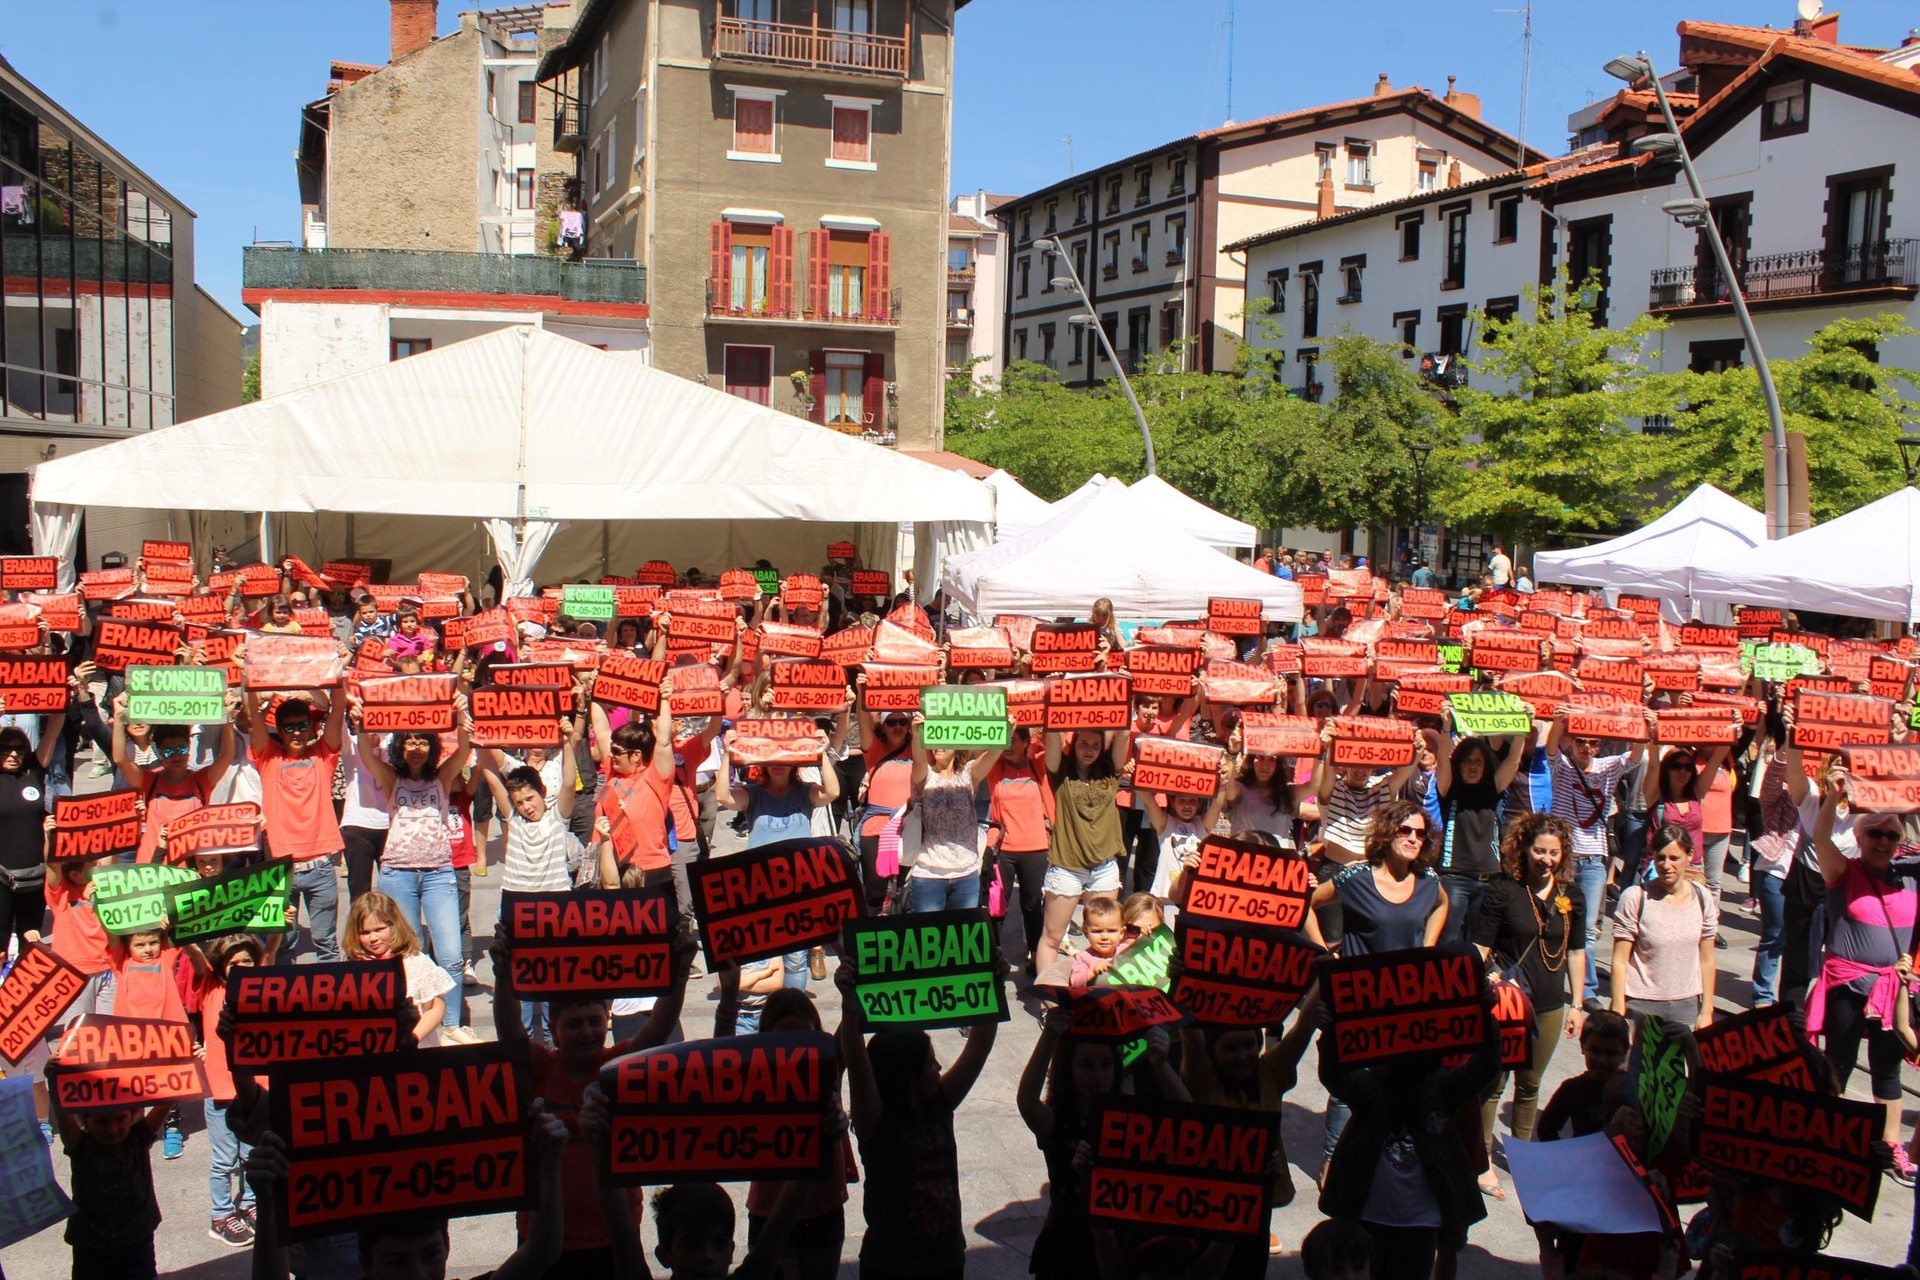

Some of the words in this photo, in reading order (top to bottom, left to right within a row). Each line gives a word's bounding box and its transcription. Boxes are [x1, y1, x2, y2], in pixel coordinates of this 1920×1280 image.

[144, 543, 188, 558] ERABAKI
[4, 559, 53, 573] ERABAKI
[147, 566, 192, 580] ERABAKI
[854, 572, 887, 582] ERABAKI
[5, 577, 52, 585] 2017-05-07
[369, 586, 419, 596] ERABAKI
[566, 589, 579, 601] SE
[583, 589, 613, 602] CONSULTA
[1404, 589, 1444, 604] ERABAKI
[1620, 599, 1659, 613] ERABAKI
[566, 607, 611, 616] 07-05-2017
[1212, 601, 1261, 617] ERABAKI
[1741, 610, 1781, 623] ERABAKI
[100, 623, 180, 651] ERABAKI
[672, 621, 732, 636] 07-05-2017
[1211, 622, 1258, 631] 2017-05-07
[1584, 621, 1641, 638] ERABAKI
[1683, 627, 1738, 645] ERABAKI
[761, 635, 817, 654] 2017-05-07
[1035, 630, 1096, 650] ERABAKI
[953, 652, 1009, 664] 2017-05-07
[1035, 656, 1094, 668] 2017-05-07
[1128, 650, 1192, 671] ERABAKI
[1378, 642, 1437, 664] ERABAKI
[1475, 653, 1535, 669] 2017-05-07
[132, 670, 150, 691] SE
[152, 671, 223, 691] CONSULTA
[512, 667, 572, 687] CONSULTA
[602, 657, 663, 683] ERABAKI
[775, 663, 790, 683] SE
[792, 663, 846, 685] CONSULTA
[882, 670, 938, 686] CONSULTA
[1581, 662, 1642, 683] ERABAKI
[364, 679, 450, 702] ERABAKI
[596, 681, 656, 705] 2017-05-07
[1049, 678, 1127, 703] ERABAKI
[1418, 677, 1471, 692] CONSULTA
[1518, 675, 1572, 698] CONSULTA
[133, 701, 219, 716] 07-05-2017
[473, 692, 555, 716] ERABAKI
[775, 692, 843, 705] 07-05-2017
[925, 692, 1005, 717] ERABAKI
[366, 709, 448, 726] 2017-05-07
[1051, 711, 1125, 725] 2017-05-07
[1799, 695, 1888, 725] ERABAKI
[475, 725, 555, 740] 2017-05-07
[736, 721, 817, 737] ERABAKI
[926, 725, 1004, 741] 2017-05-07
[1351, 718, 1413, 740] CONSULTA
[1572, 718, 1641, 734] 2017-05-07
[1661, 725, 1731, 738] 2017-05-07
[1337, 748, 1411, 765] 07-05-2017
[1138, 769, 1213, 792] 2017-05-07
[60, 796, 135, 822] 2017-05-07
[398, 794, 437, 807] OVER
[55, 822, 138, 857] ERABAKI
[168, 825, 256, 861] ERABAKI
[1198, 843, 1309, 893] ERABAKI
[701, 845, 847, 915] ERABAKI
[175, 864, 286, 921] ERABAKI
[1192, 889, 1300, 923] 2017-05-07
[177, 903, 281, 936] 2017-05-07
[513, 897, 666, 938] ERABAKI
[714, 898, 854, 955] 2017-05-07
[856, 921, 991, 975] ERABAKI
[1183, 928, 1316, 986] ERABAKI
[516, 953, 666, 985] 2017-05-07
[237, 971, 395, 1015] ERABAKI
[1329, 956, 1478, 1015] ERABAKI
[863, 981, 991, 1016] 2017-05-07
[1177, 985, 1293, 1020] 2017-05-07
[4, 974, 76, 1053] 2017-05-07
[59, 1024, 192, 1066] ERABAKI
[238, 1028, 393, 1059] 2017-05-07
[1341, 1014, 1478, 1055] 2017-05-07
[1699, 1015, 1799, 1075] RABAKI
[62, 1070, 194, 1103] 2017-05-07
[616, 1047, 820, 1104] ERABAKI
[288, 1061, 518, 1149] ERABAKI
[1704, 1083, 1873, 1161] ERABAKI
[617, 1125, 816, 1163] 2017-05-07
[1098, 1108, 1269, 1176] ERABAKI
[1703, 1139, 1866, 1195] 2017-05-07
[294, 1151, 518, 1216] 2017-05-07
[1095, 1178, 1258, 1225] 2017-05-07
